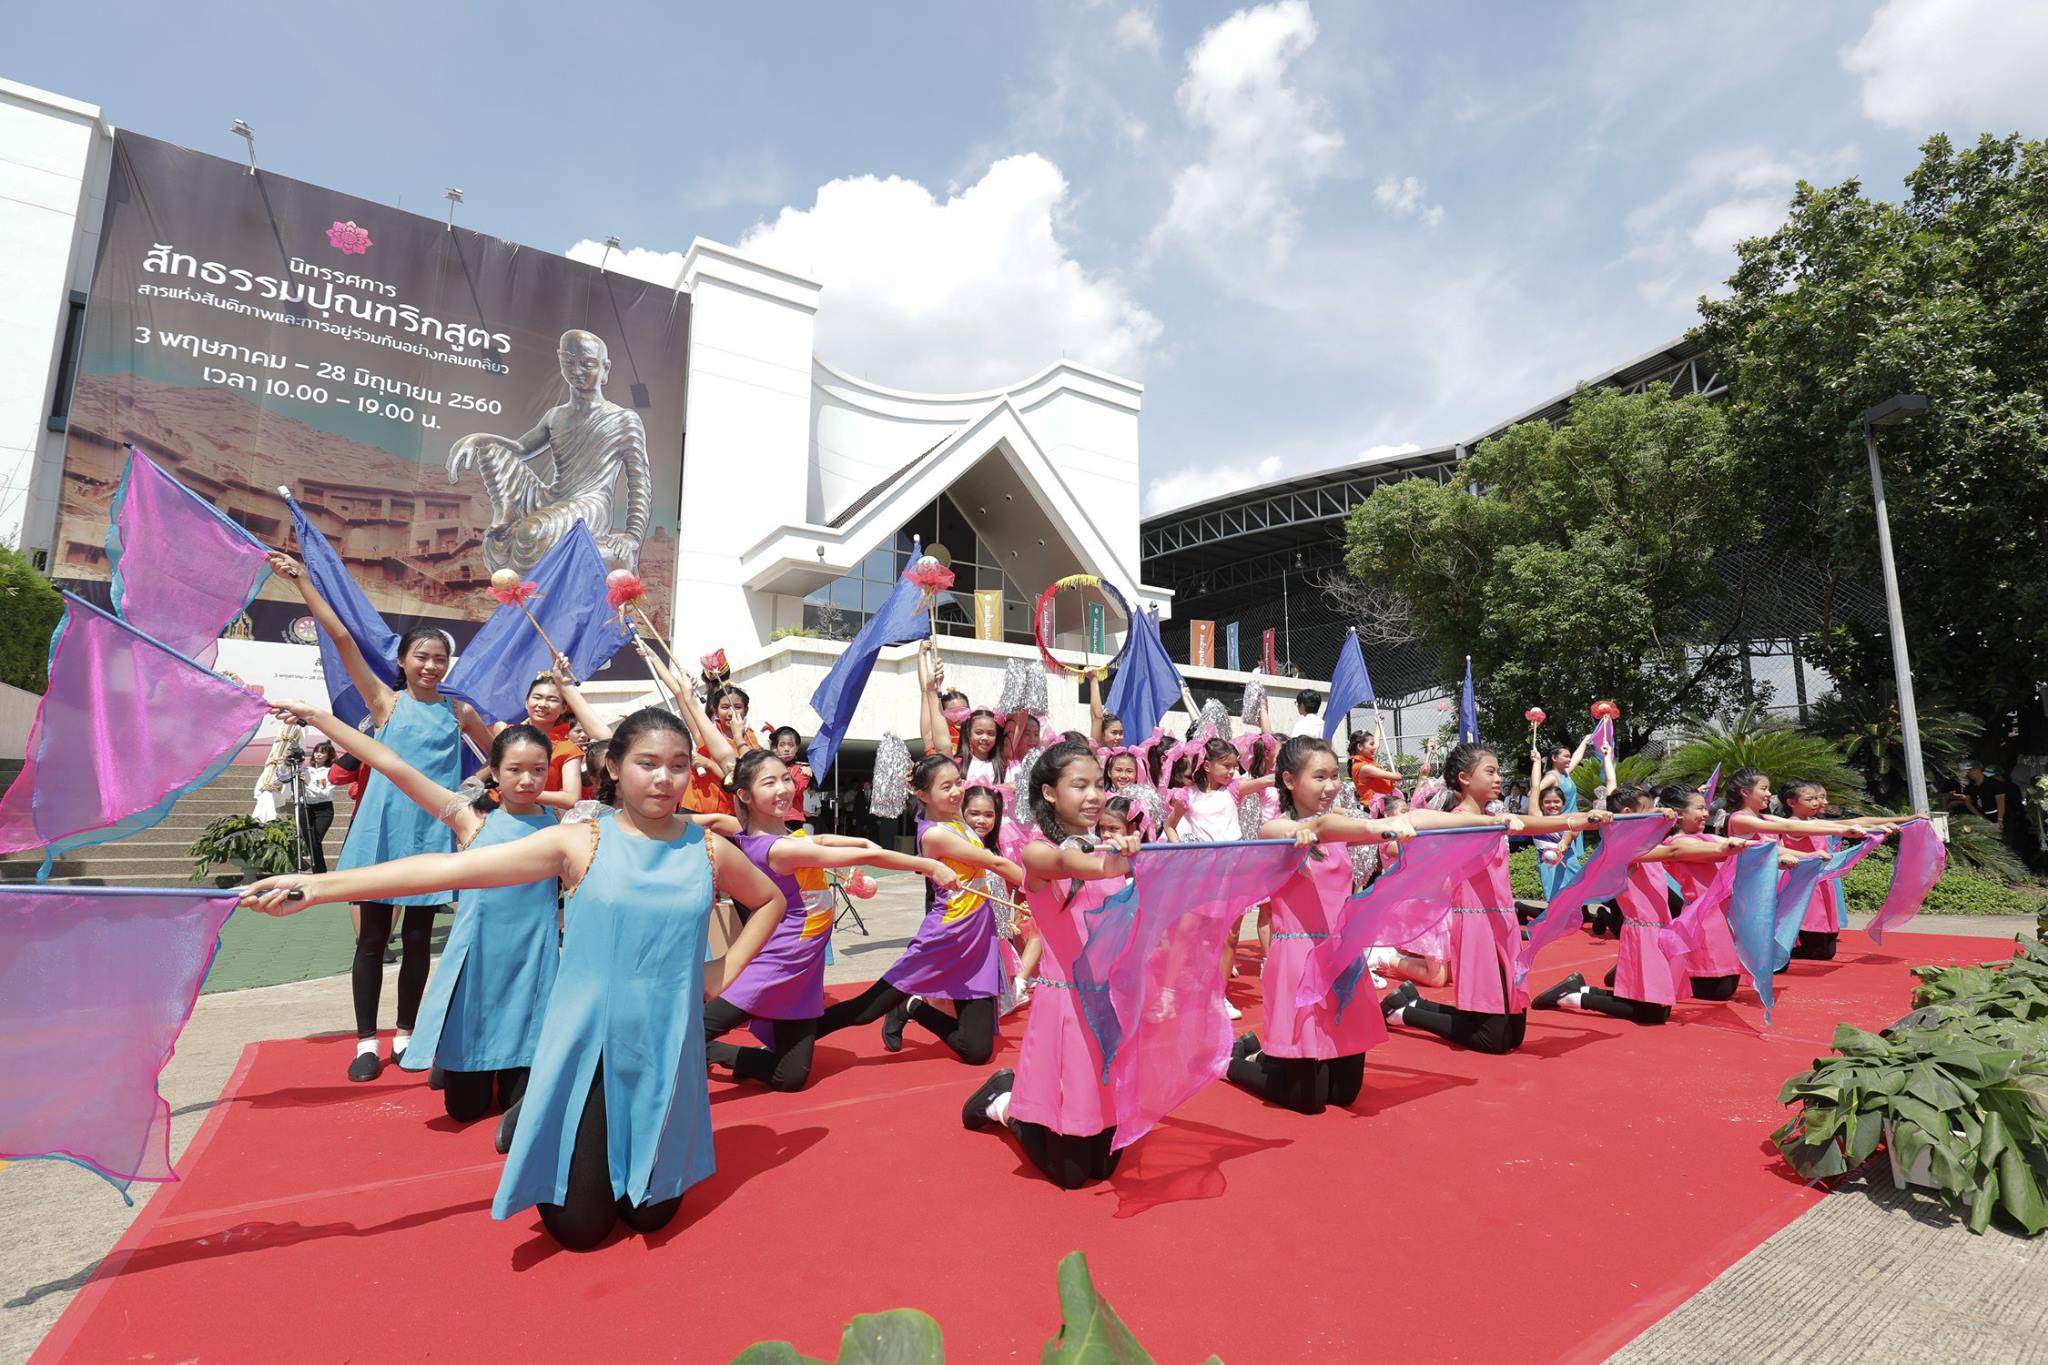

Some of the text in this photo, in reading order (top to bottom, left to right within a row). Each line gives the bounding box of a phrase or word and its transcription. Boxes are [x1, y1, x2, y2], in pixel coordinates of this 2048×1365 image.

[142, 242, 512, 354] สัทธรรมปุณฑริกสูตร
[289, 257, 397, 298] นิทรรศการ
[134, 326, 152, 344] 3
[158, 330, 287, 370] พฤษภาคม
[316, 362, 345, 383] 28
[353, 367, 442, 405] มิถุนายน
[447, 392, 503, 415] 2560
[137, 284, 510, 375] สารแห่งสันติภาพและการอยู่ร่วมกันอย่างกลมเกลียว
[203, 366, 258, 392] เวลา
[264, 378, 329, 404] 10.00
[357, 396, 415, 423] 19.00
[421, 413, 441, 430] น.
